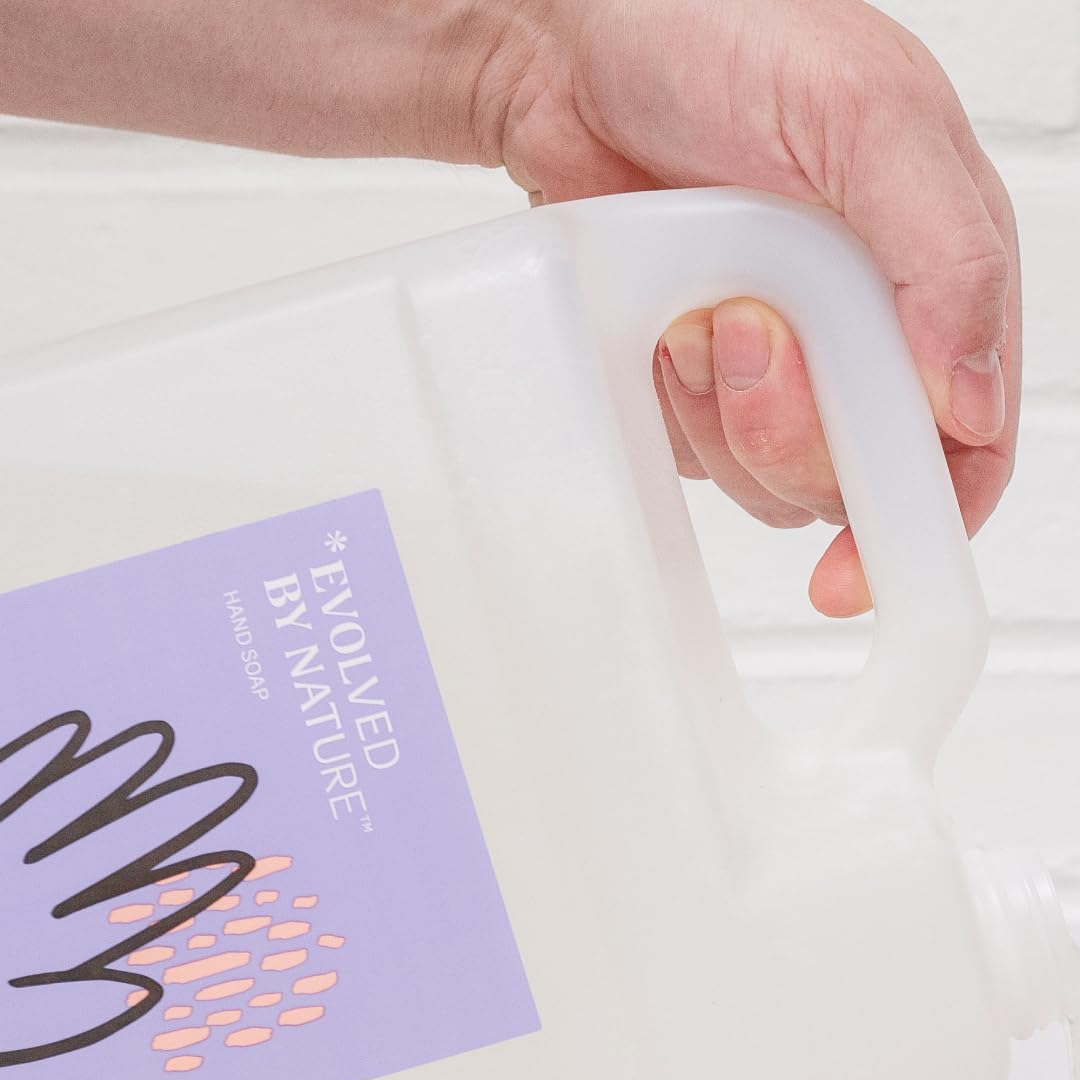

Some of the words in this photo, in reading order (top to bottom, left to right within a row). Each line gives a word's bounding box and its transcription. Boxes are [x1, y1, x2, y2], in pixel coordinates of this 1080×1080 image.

[263, 573, 313, 631] BY
[223, 589, 252, 647] HAND
[240, 647, 270, 702] SOAP
